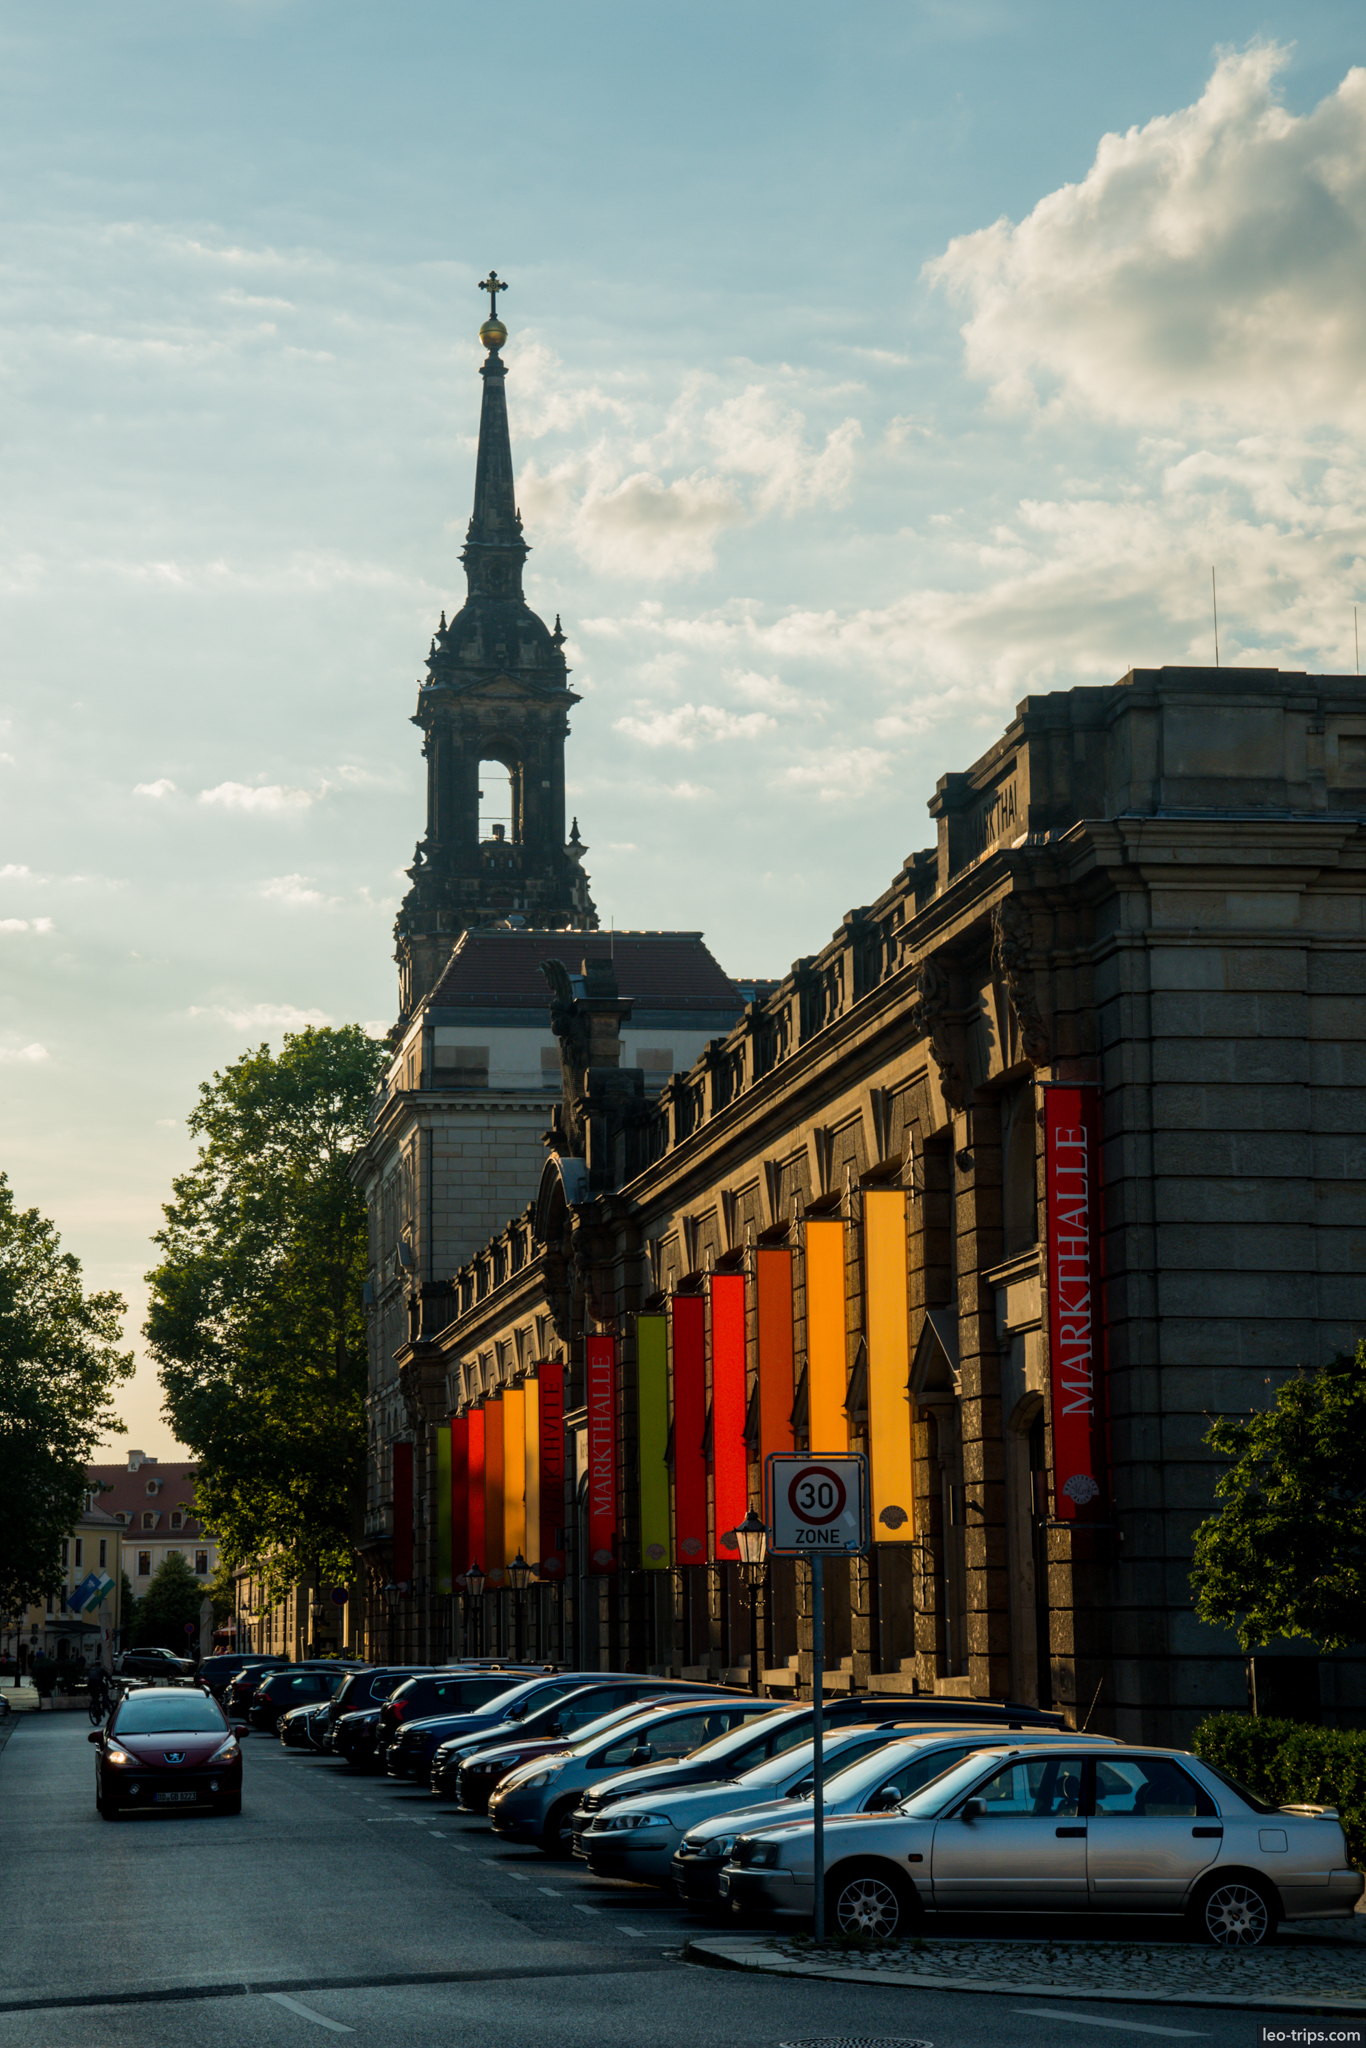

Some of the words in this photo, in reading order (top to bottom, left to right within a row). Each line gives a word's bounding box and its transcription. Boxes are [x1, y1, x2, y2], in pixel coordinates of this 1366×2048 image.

[1055, 1124, 1094, 1417] MARKTHALLE
[593, 1355, 612, 1516] MARKTHALLE
[795, 1529, 840, 1544] ZONE
[800, 1482, 833, 1509] 30
